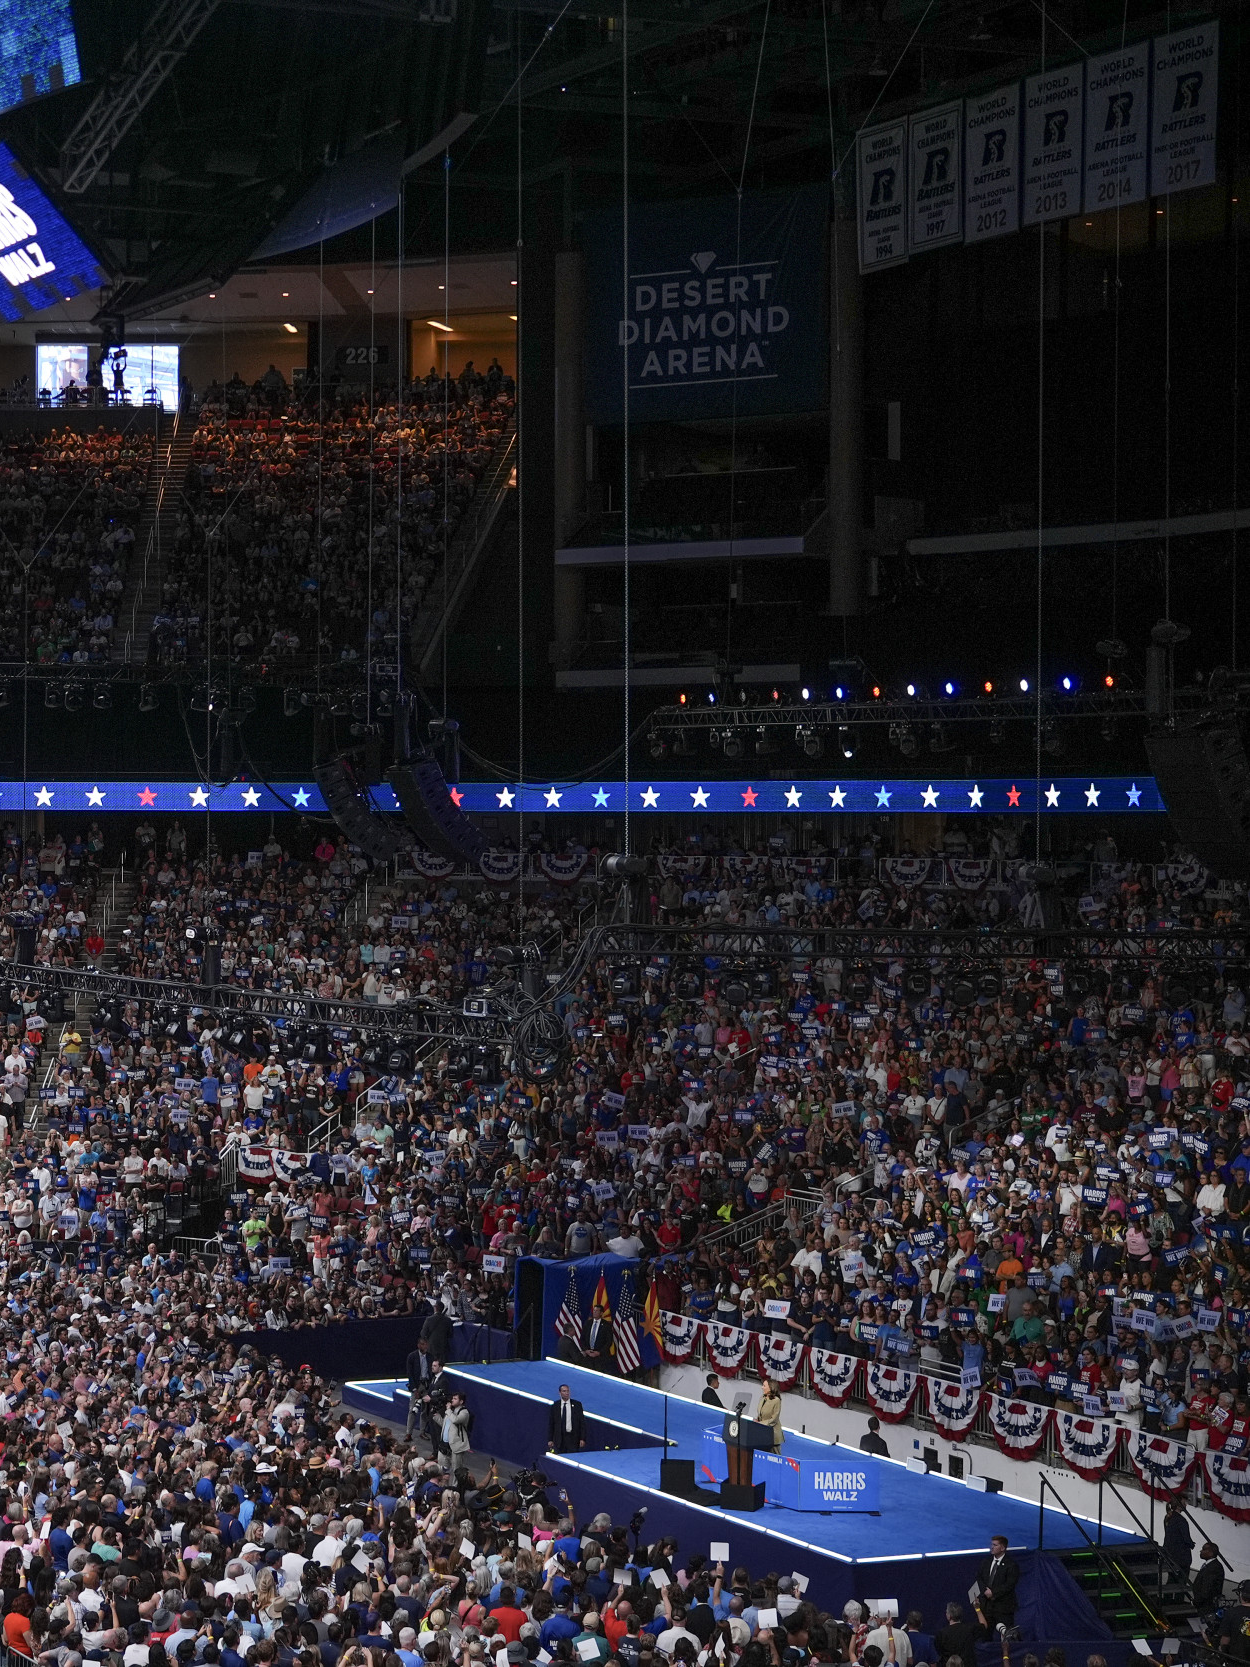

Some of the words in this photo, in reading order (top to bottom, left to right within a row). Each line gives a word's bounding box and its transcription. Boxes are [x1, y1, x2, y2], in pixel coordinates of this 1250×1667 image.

[1168, 35, 1204, 54] WORLD
[1101, 57, 1135, 75] WORLD
[1156, 46, 1214, 71] CHAMPIONS
[1037, 76, 1069, 94] WORLD
[1090, 67, 1144, 91] CHAMPIONS
[977, 97, 1007, 114] WORLD
[1028, 87, 1079, 108] CHAMPIONS
[968, 106, 1016, 129] CHAMPIONS
[1161, 114, 1206, 134] RATTLERS
[1094, 133, 1137, 153] RATTLERS
[1032, 149, 1072, 168] RATTLERS
[973, 168, 1011, 186] RATTLERS
[1166, 160, 1201, 185] 2017
[1098, 178, 1132, 203] 2014
[1035, 191, 1067, 214] 2013
[926, 220, 945, 236] 1997
[976, 209, 1007, 233] 2012
[876, 244, 893, 259] 1994
[635, 273, 772, 312] DESERT
[618, 305, 790, 346] DIAMOND
[346, 347, 378, 364] 226
[640, 342, 764, 377] ARENA
[1149, 1133, 1168, 1143] HARRIS
[950, 1148, 970, 1160] HARRIS
[1084, 1189, 1106, 1199] HARRIS
[309, 1216, 327, 1225] HARRIS
[913, 1231, 936, 1242] HARRIS
[860, 1325, 879, 1335] HARRIS
[887, 1340, 896, 1349] WE
[896, 1342, 909, 1352] WIN
[1048, 1375, 1068, 1386] HARRIS
[1050, 1383, 1064, 1391] WALZ
[1071, 1382, 1088, 1393] HARRIS
[814, 1471, 866, 1490] HARRIS
[823, 1490, 857, 1501] WALZ
